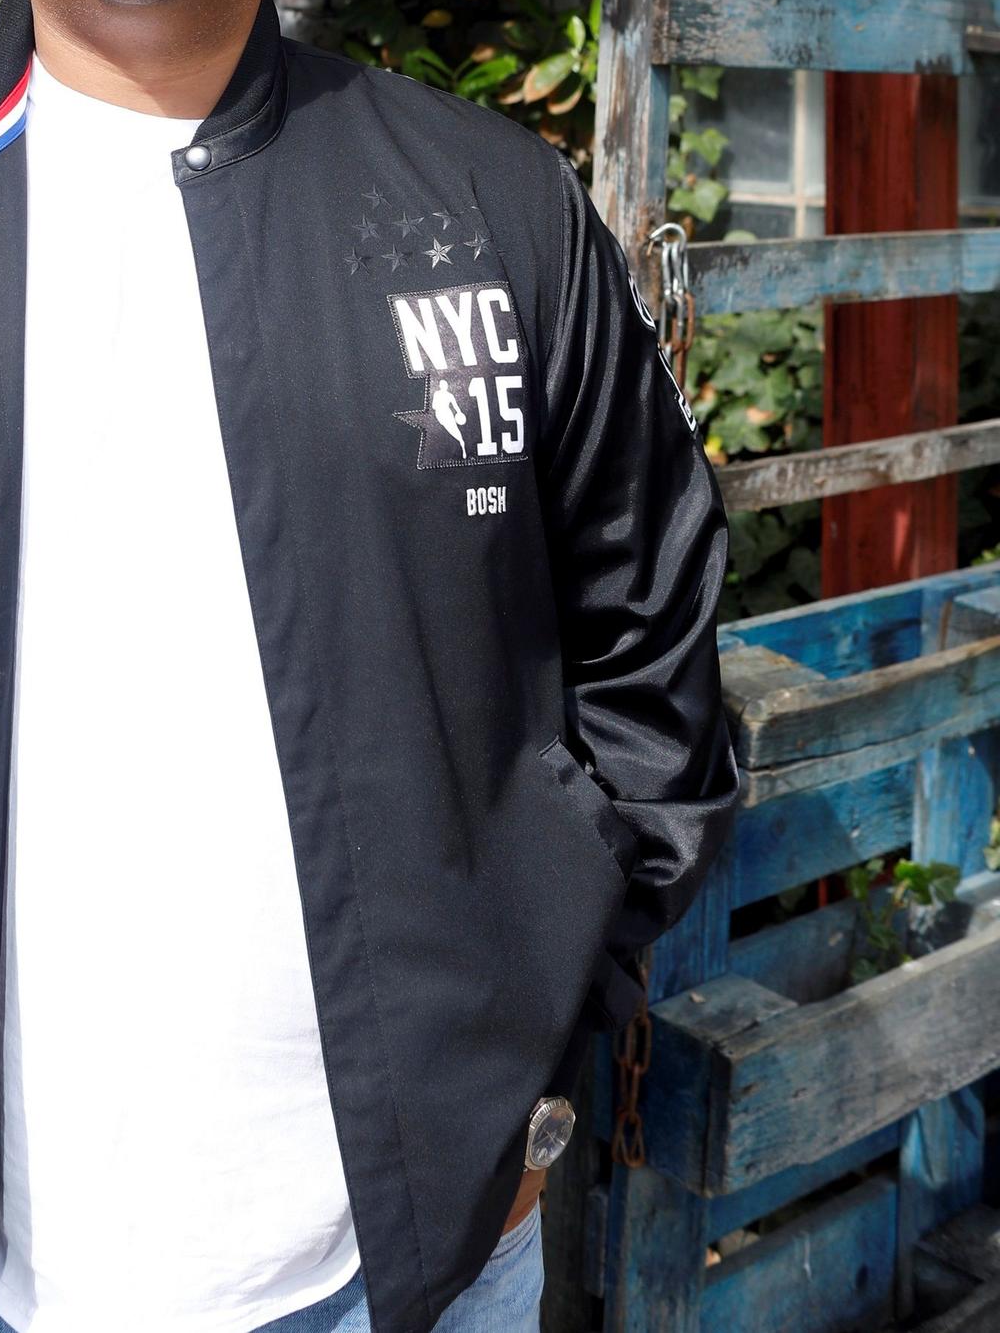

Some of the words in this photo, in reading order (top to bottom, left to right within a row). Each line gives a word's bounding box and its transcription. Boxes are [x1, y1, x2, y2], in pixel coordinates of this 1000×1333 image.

[395, 288, 519, 371] NYC
[468, 375, 525, 456] 15
[466, 486, 507, 516] BOSH
